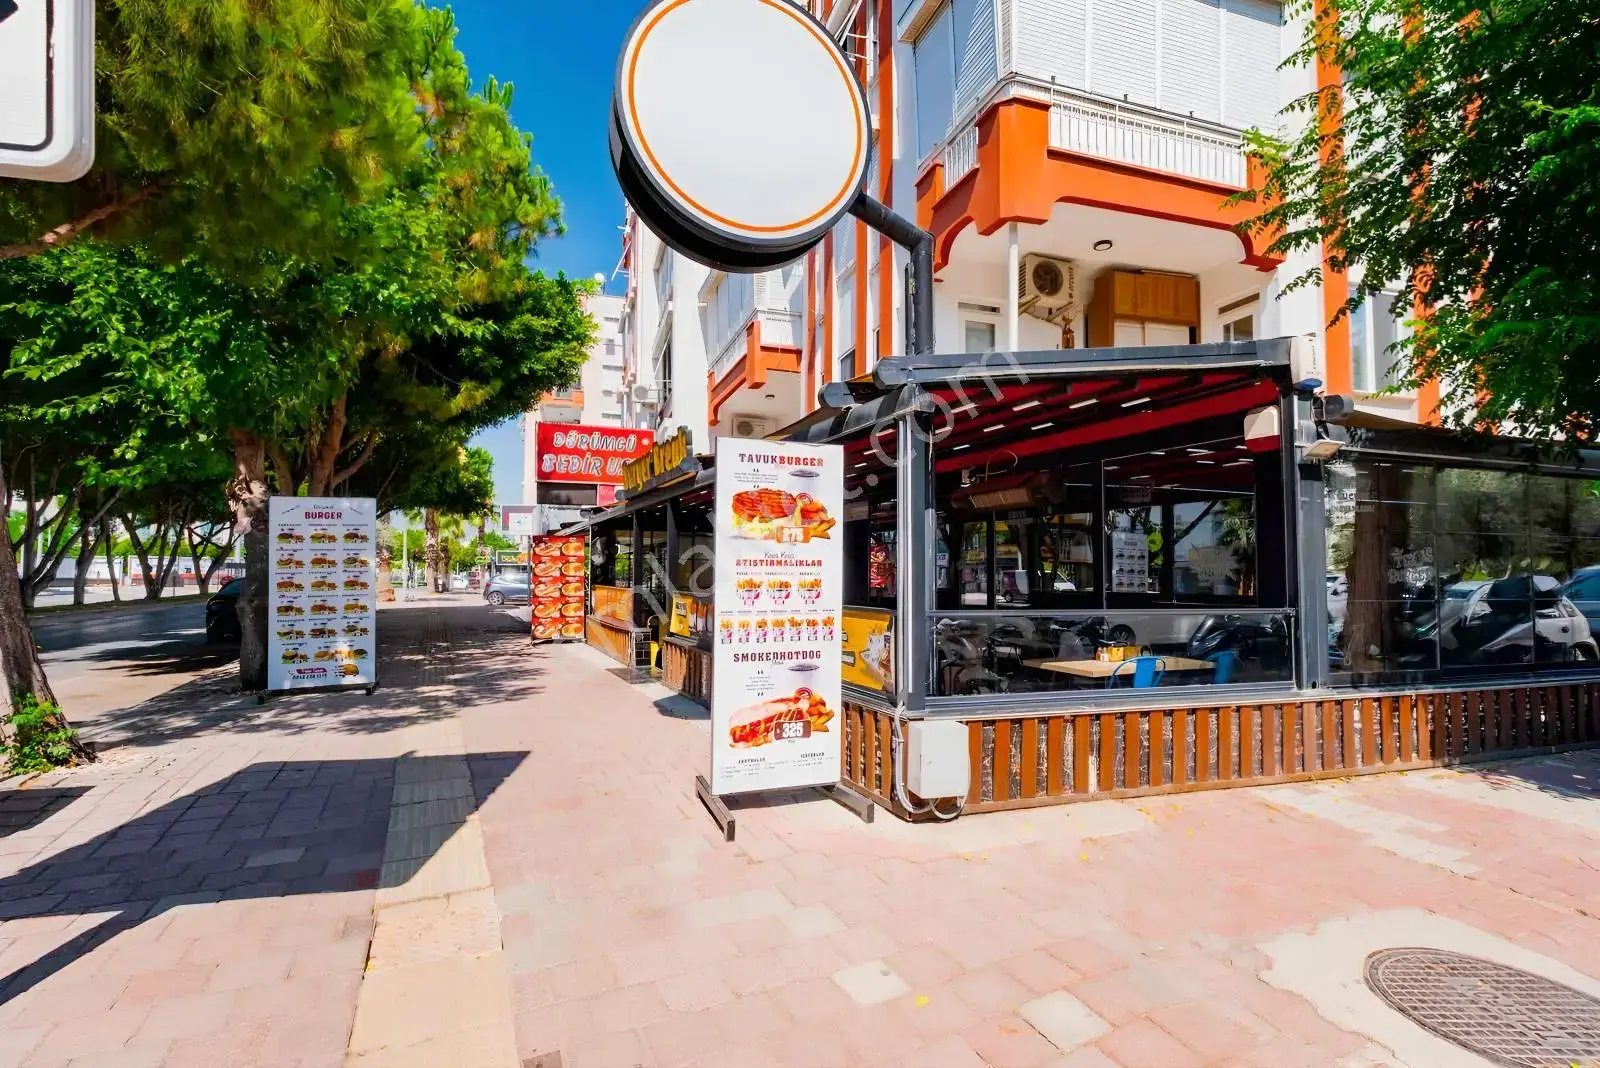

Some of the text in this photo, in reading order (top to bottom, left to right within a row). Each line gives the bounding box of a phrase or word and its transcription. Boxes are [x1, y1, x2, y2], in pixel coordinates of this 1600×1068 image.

[542, 452, 604, 477] BEDİR
[738, 453, 824, 467] TAVUKBURGER
[304, 511, 343, 520] BURGER
